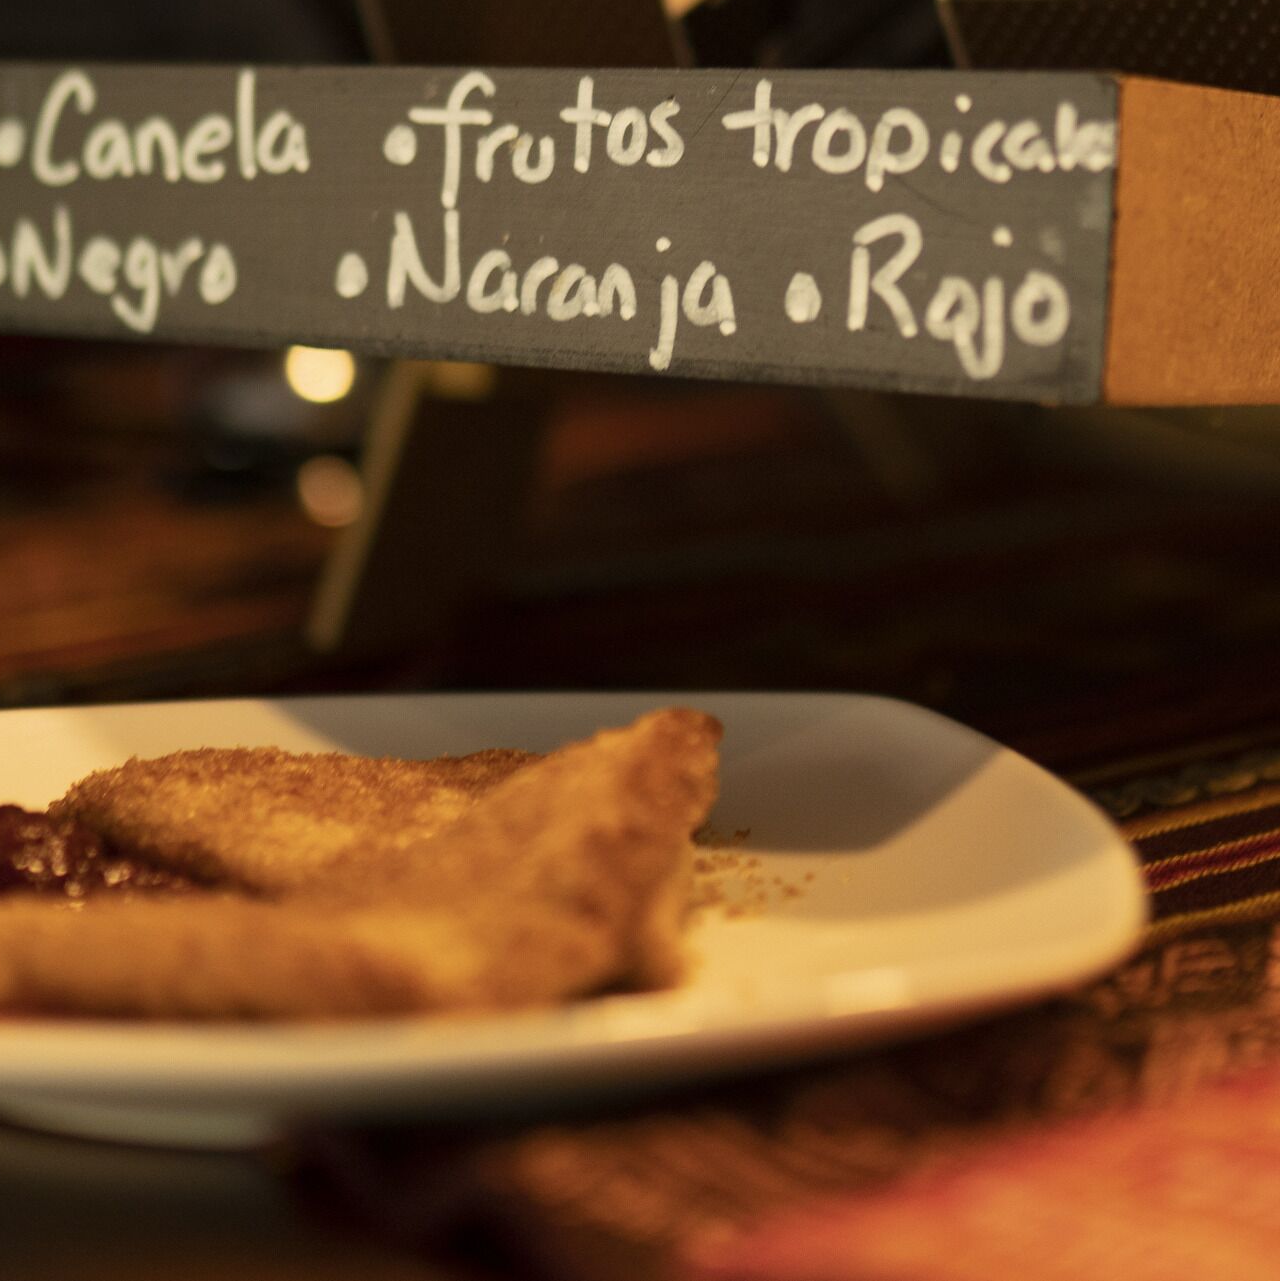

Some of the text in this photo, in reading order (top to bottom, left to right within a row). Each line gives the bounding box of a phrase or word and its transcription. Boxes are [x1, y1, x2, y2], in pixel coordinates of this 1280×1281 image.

[31, 70, 310, 186] Canela
[408, 72, 688, 210] frutos
[10, 202, 237, 334] Negro
[387, 210, 738, 370] Naranja
